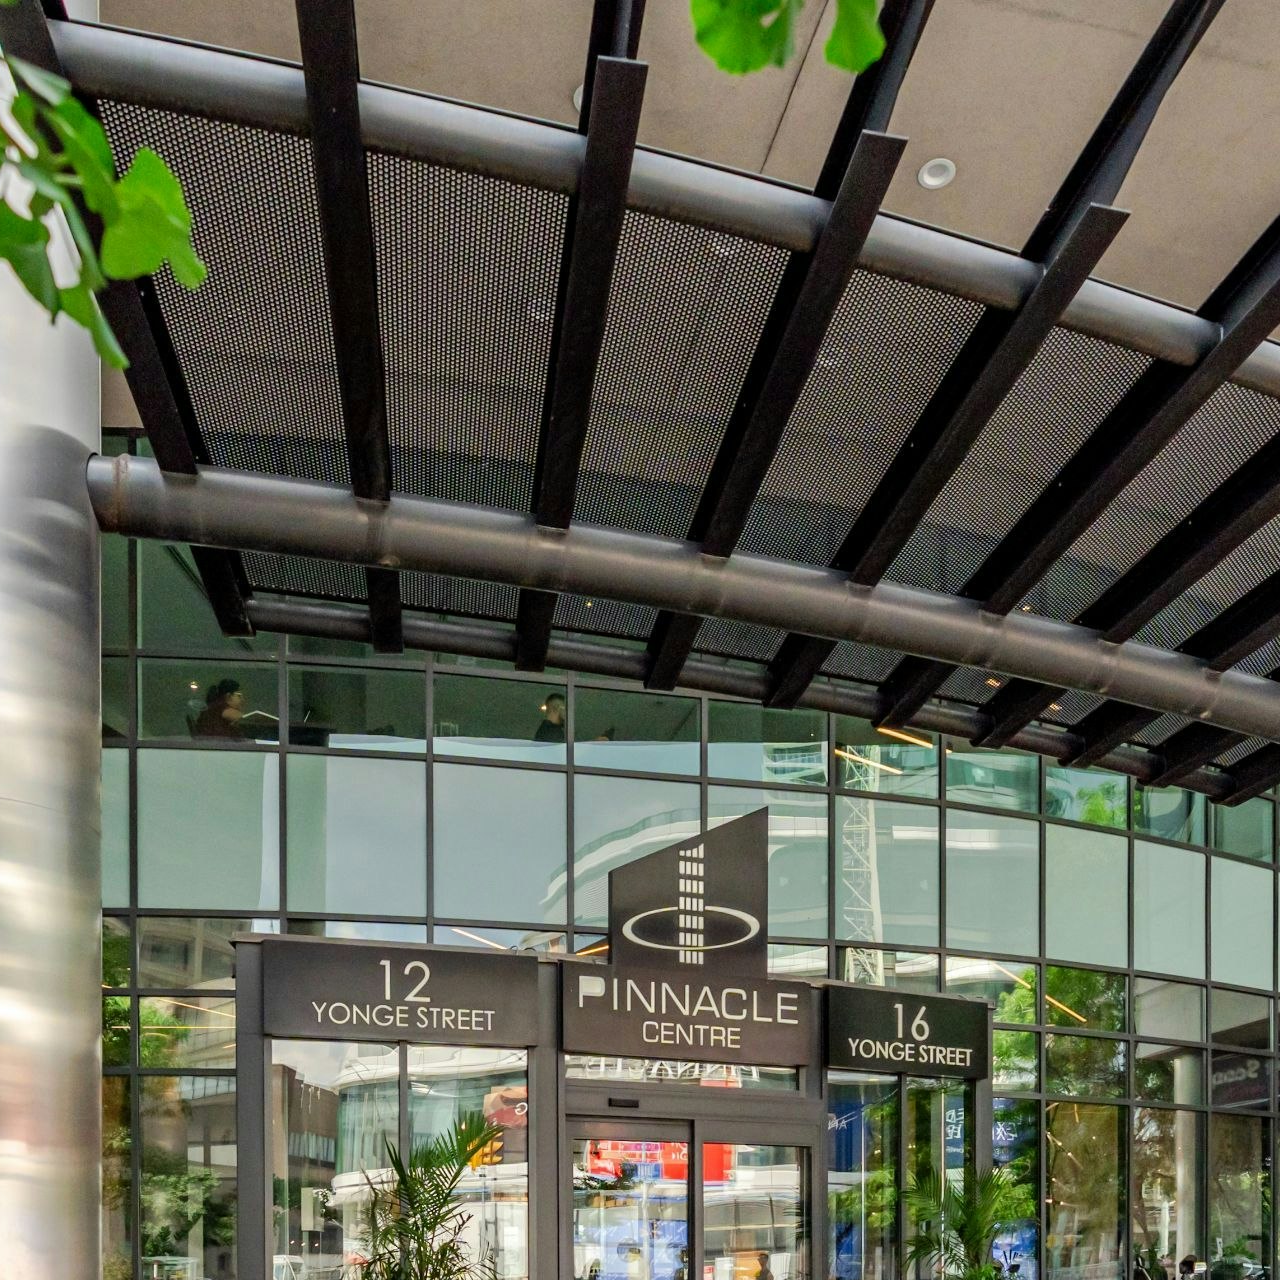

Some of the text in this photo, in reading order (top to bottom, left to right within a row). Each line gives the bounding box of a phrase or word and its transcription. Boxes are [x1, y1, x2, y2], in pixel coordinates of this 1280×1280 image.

[379, 959, 431, 1003] 12
[311, 1001, 496, 1031] YONGE STREET
[578, 975, 799, 1025] PINNACLE
[642, 1020, 741, 1049] CENTRE
[893, 1003, 930, 1041] 16
[847, 1037, 973, 1067] YONGE STREET
